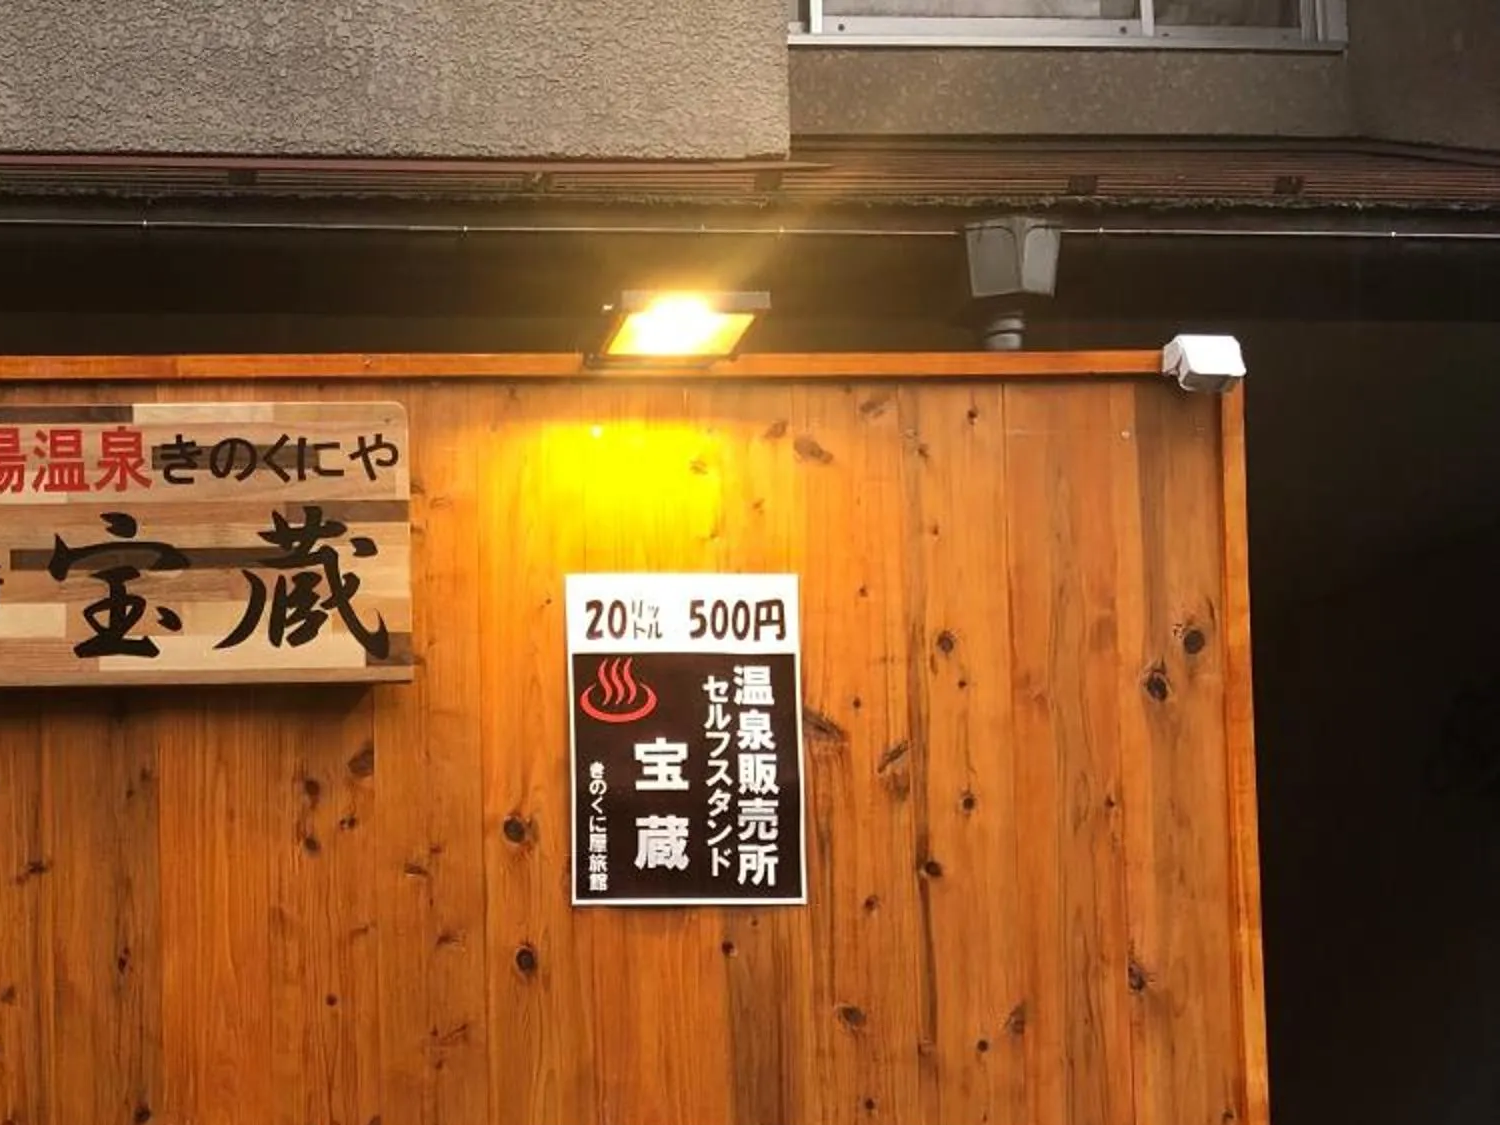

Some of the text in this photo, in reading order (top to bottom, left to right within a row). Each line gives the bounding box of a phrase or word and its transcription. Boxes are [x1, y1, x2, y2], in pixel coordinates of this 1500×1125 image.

[159, 432, 399, 485] きのくにや
[49, 506, 390, 659] 宝蔵
[689, 599, 786, 641] 500円
[588, 761, 609, 892] きのくに屋旅館
[634, 737, 690, 871] 宝蔵
[702, 675, 732, 877] セルフスタンド
[734, 664, 780, 887] 温泉販売所
